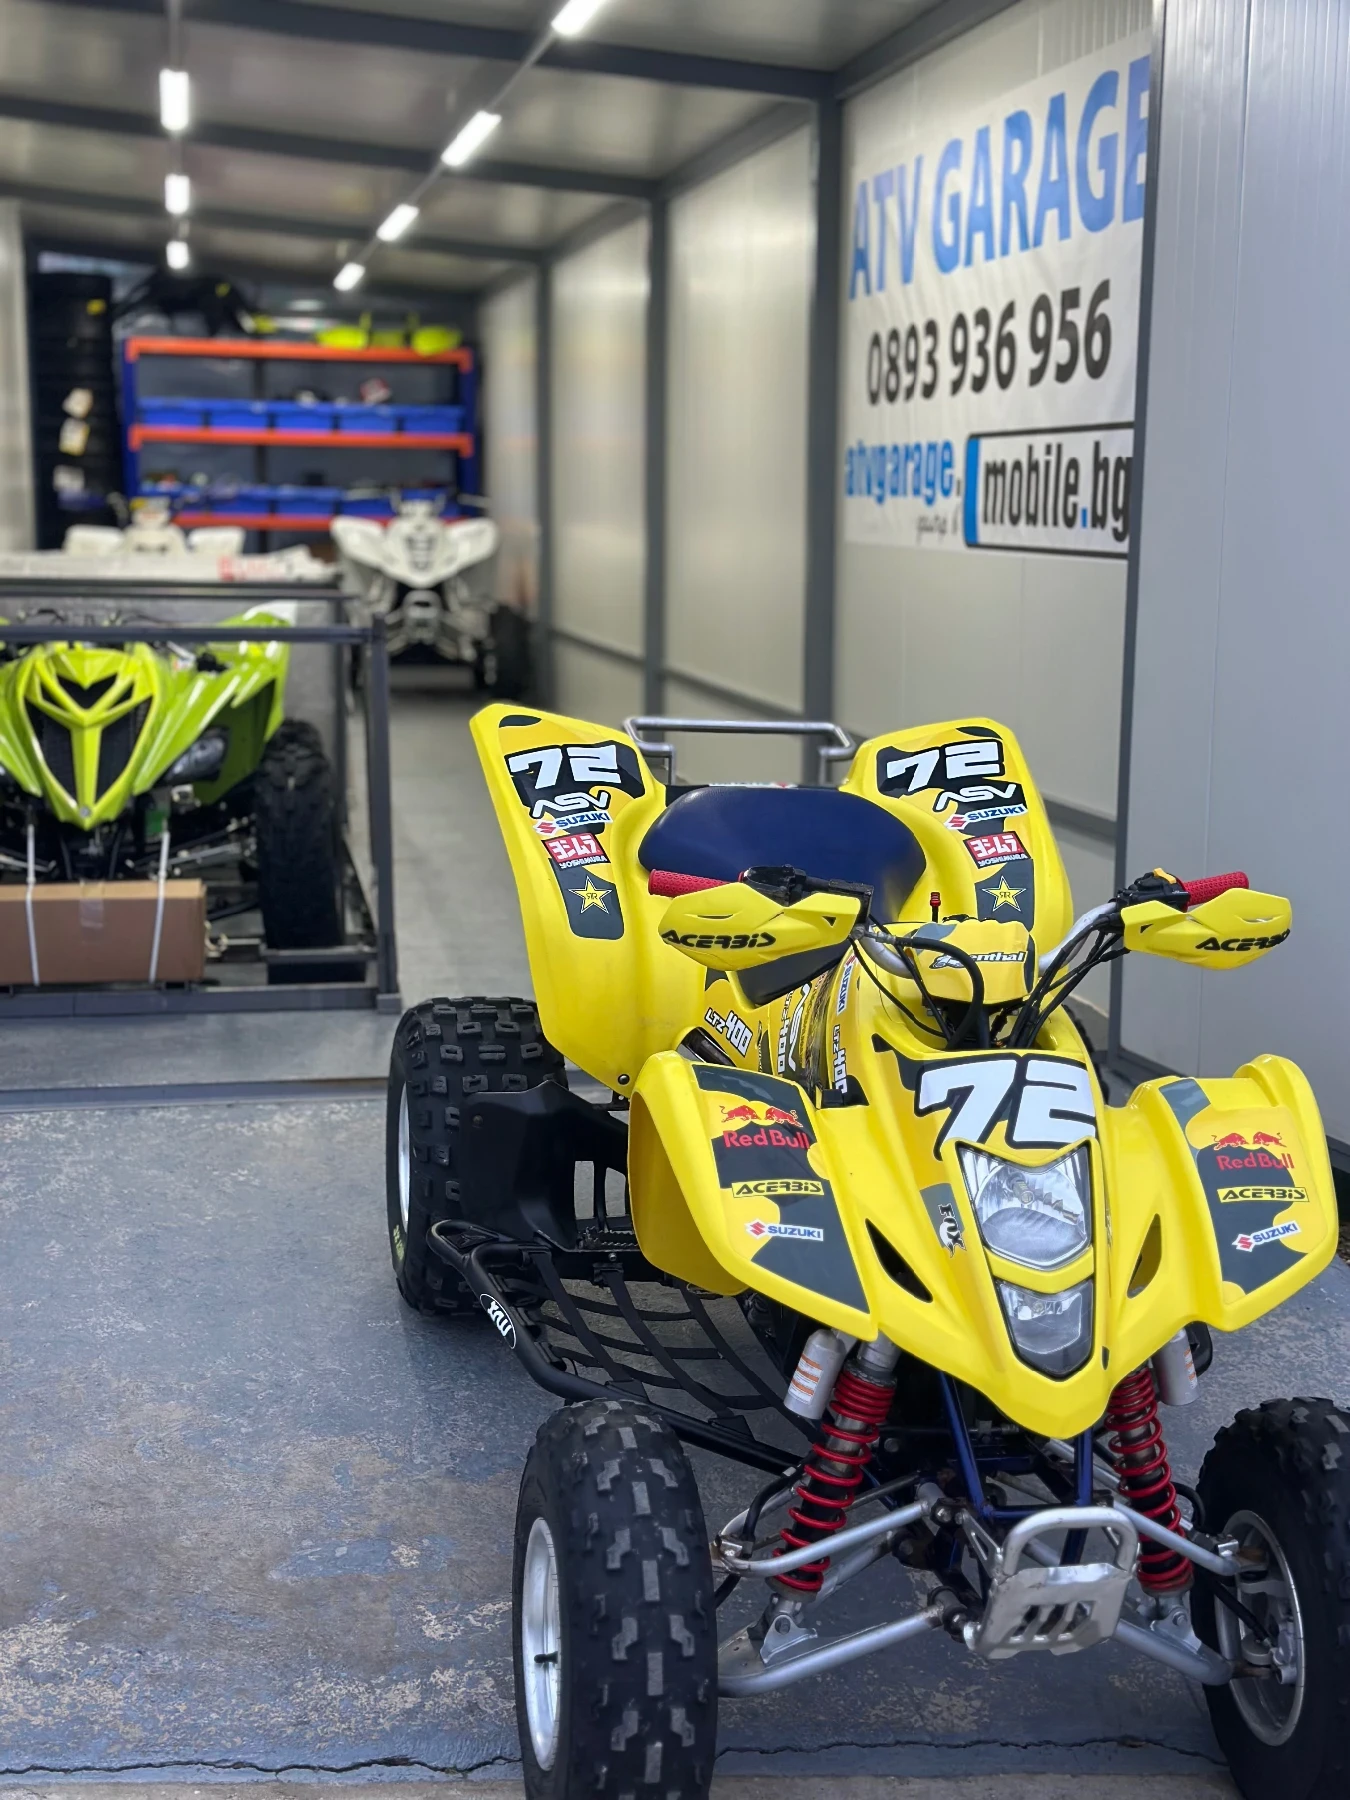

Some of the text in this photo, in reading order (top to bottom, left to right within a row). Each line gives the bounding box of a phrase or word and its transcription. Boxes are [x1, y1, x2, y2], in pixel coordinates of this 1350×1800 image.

[850, 55, 1150, 299] ATV GARAGE
[866, 278, 1112, 405] 0893 936 956
[982, 440, 1132, 543] mobile.bg
[507, 744, 622, 790] 72
[886, 741, 1001, 791] 72
[555, 812, 611, 829] SUZUKI
[966, 805, 1025, 821] SUZUKI
[660, 929, 777, 949] ACERBIS
[704, 1007, 754, 1058] LTZ400
[918, 1058, 1098, 1146] 72
[722, 1130, 810, 1150] Red Bull
[1216, 1152, 1295, 1171] Red Bull
[735, 1180, 823, 1195] ACERBIS
[1221, 1188, 1307, 1201] ACERBIS
[766, 1224, 822, 1240] SUZUKI
[1252, 1222, 1298, 1243] SUZUKI
